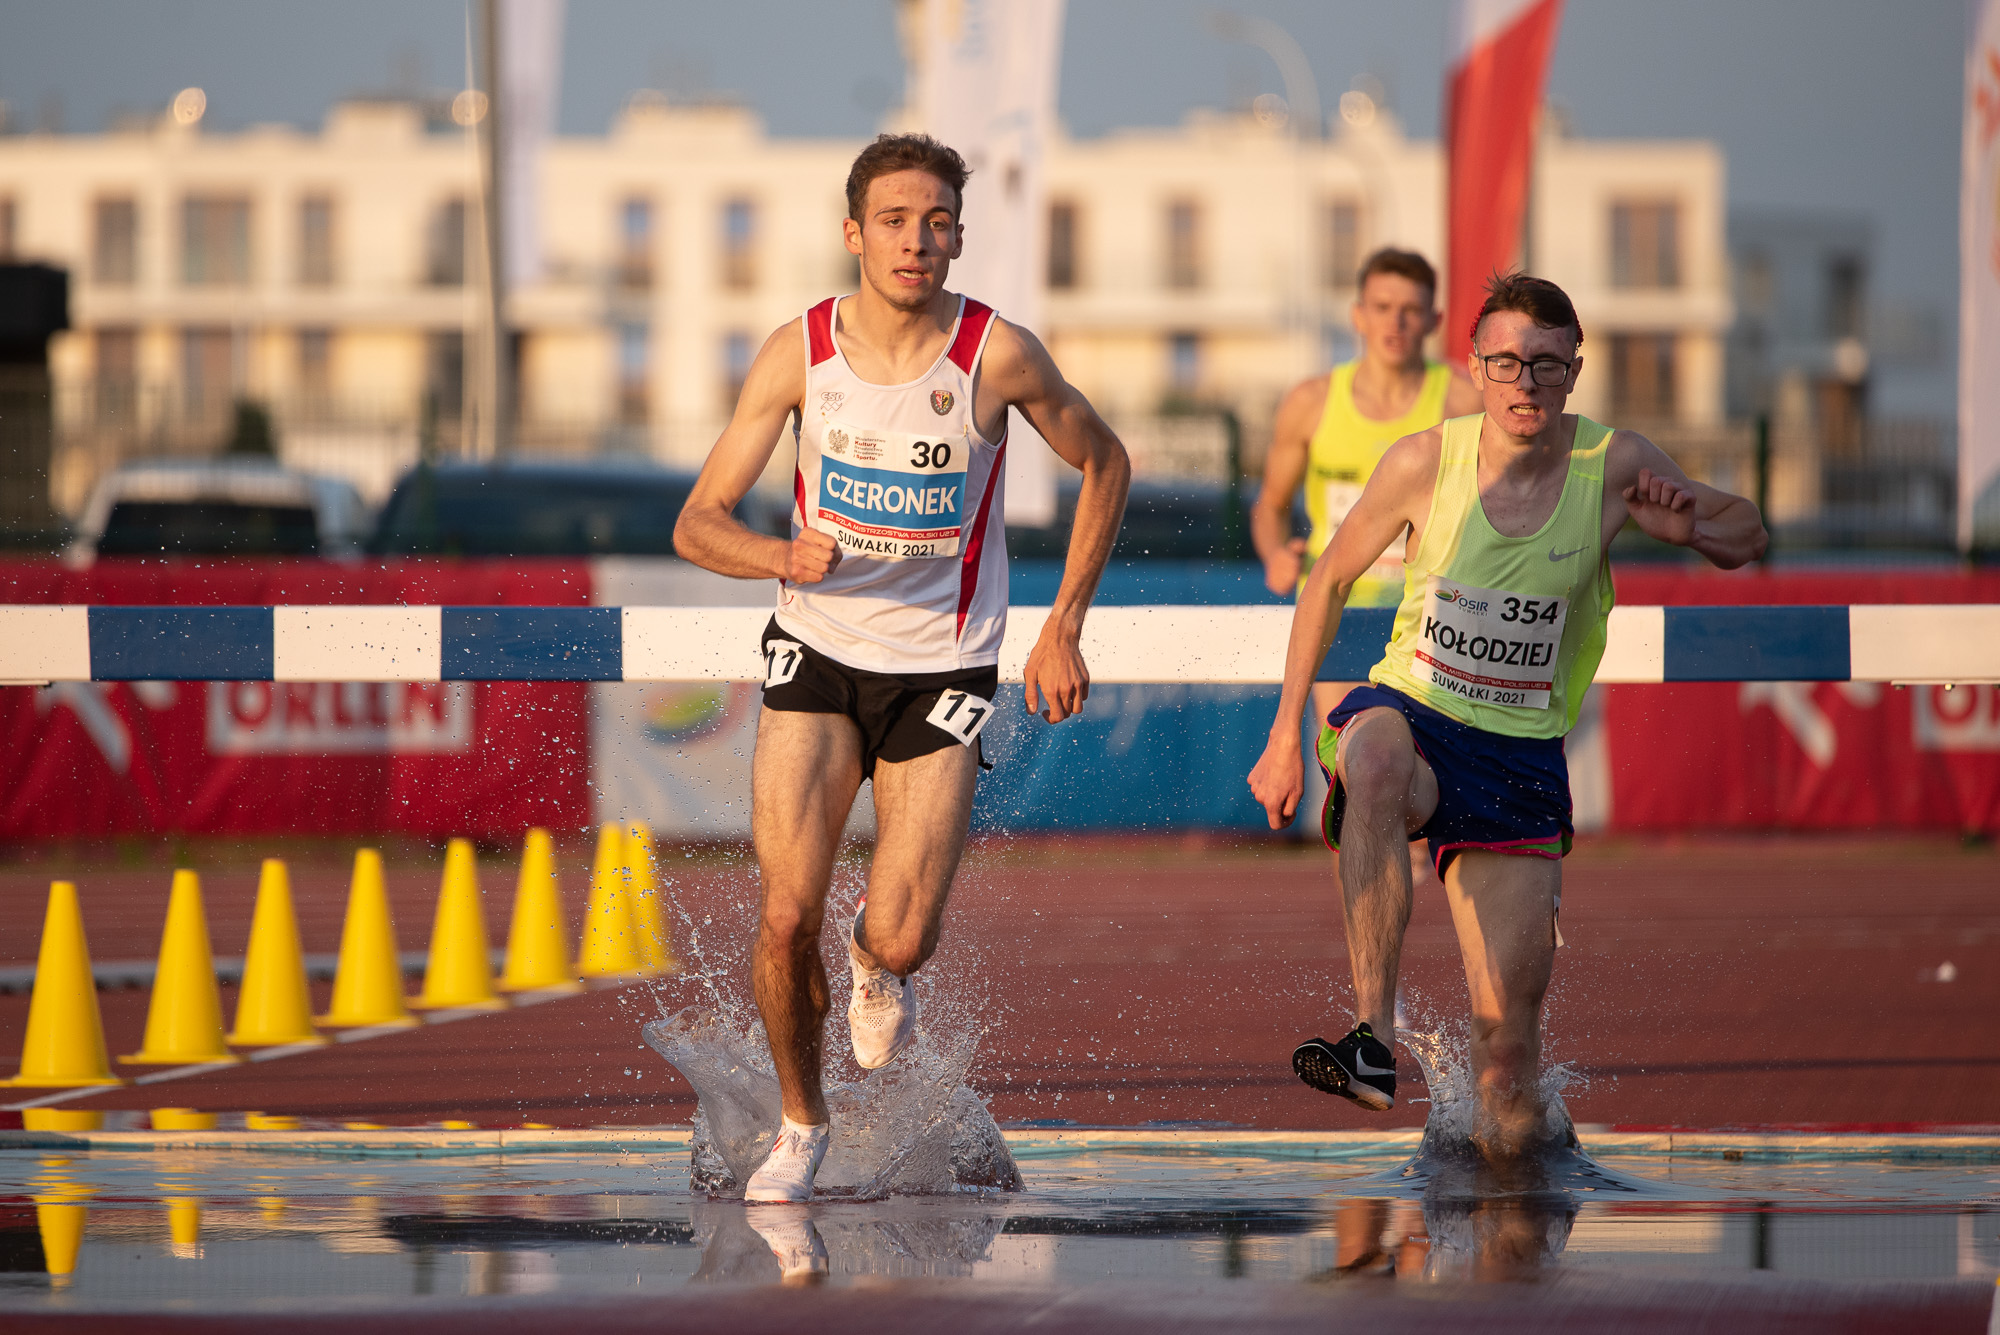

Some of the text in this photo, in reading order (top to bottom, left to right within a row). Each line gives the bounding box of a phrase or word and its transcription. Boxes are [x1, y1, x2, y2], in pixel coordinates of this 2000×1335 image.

[855, 440, 877, 448] Kultury
[910, 441, 951, 468] 30
[826, 471, 958, 515] CZERONEK
[823, 511, 835, 520] 38.
[836, 517, 853, 528] PZLA
[852, 523, 909, 538] MISTRZOSTWA
[910, 531, 938, 539] POLSKI
[837, 530, 935, 556] SUWAŁKI 2021
[1458, 597, 1489, 612] OSIR
[1500, 597, 1559, 624] 354
[1424, 615, 1554, 667] KOŁODZIEJ
[767, 646, 797, 680] 11
[1431, 659, 1448, 672] PZLA
[1448, 669, 1502, 686] MISTRZOSTWA
[1431, 671, 1525, 704] SUWAŁKI 2021
[943, 692, 986, 737] 11
